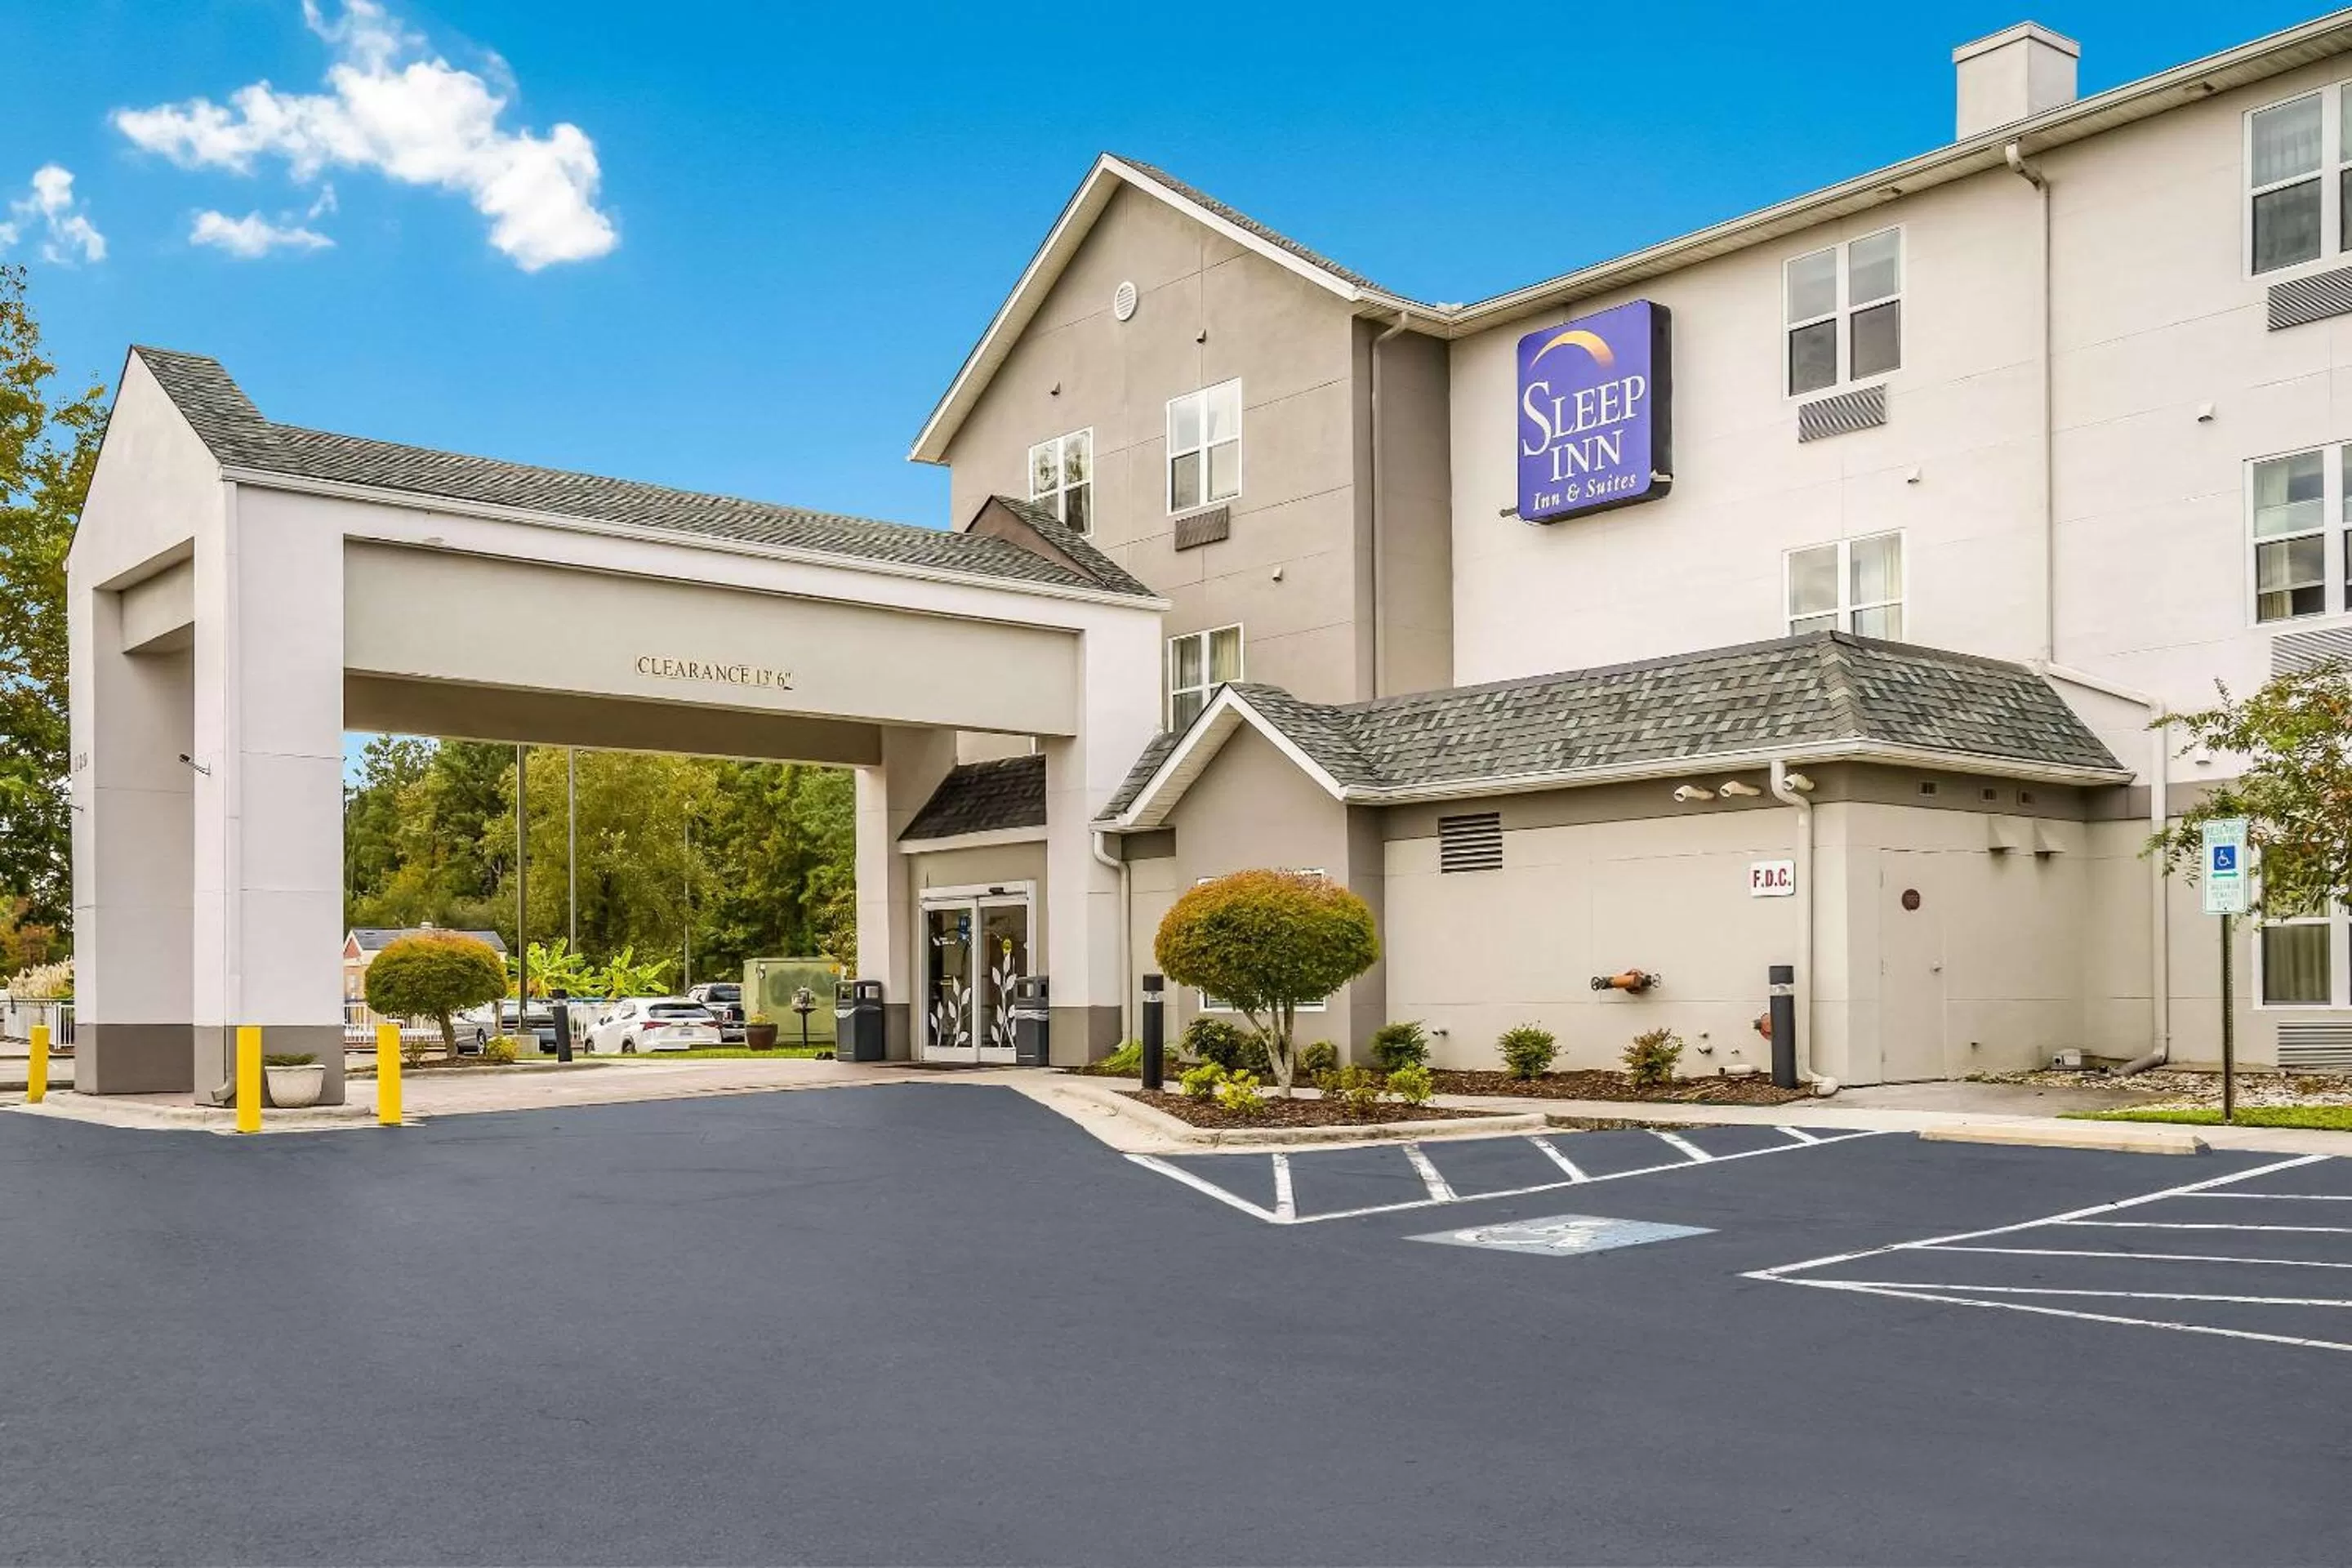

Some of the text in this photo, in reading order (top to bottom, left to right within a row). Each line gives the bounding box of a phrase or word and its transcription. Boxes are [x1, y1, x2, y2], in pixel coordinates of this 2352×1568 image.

[1523, 376, 1646, 457] SLEEP
[1550, 430, 1624, 482] INN
[1533, 474, 1637, 511] Inn & Suites
[638, 657, 749, 684] CLEARANCE
[2208, 835, 2242, 844] PAIN
[1753, 868, 1792, 888] F.D.C.
